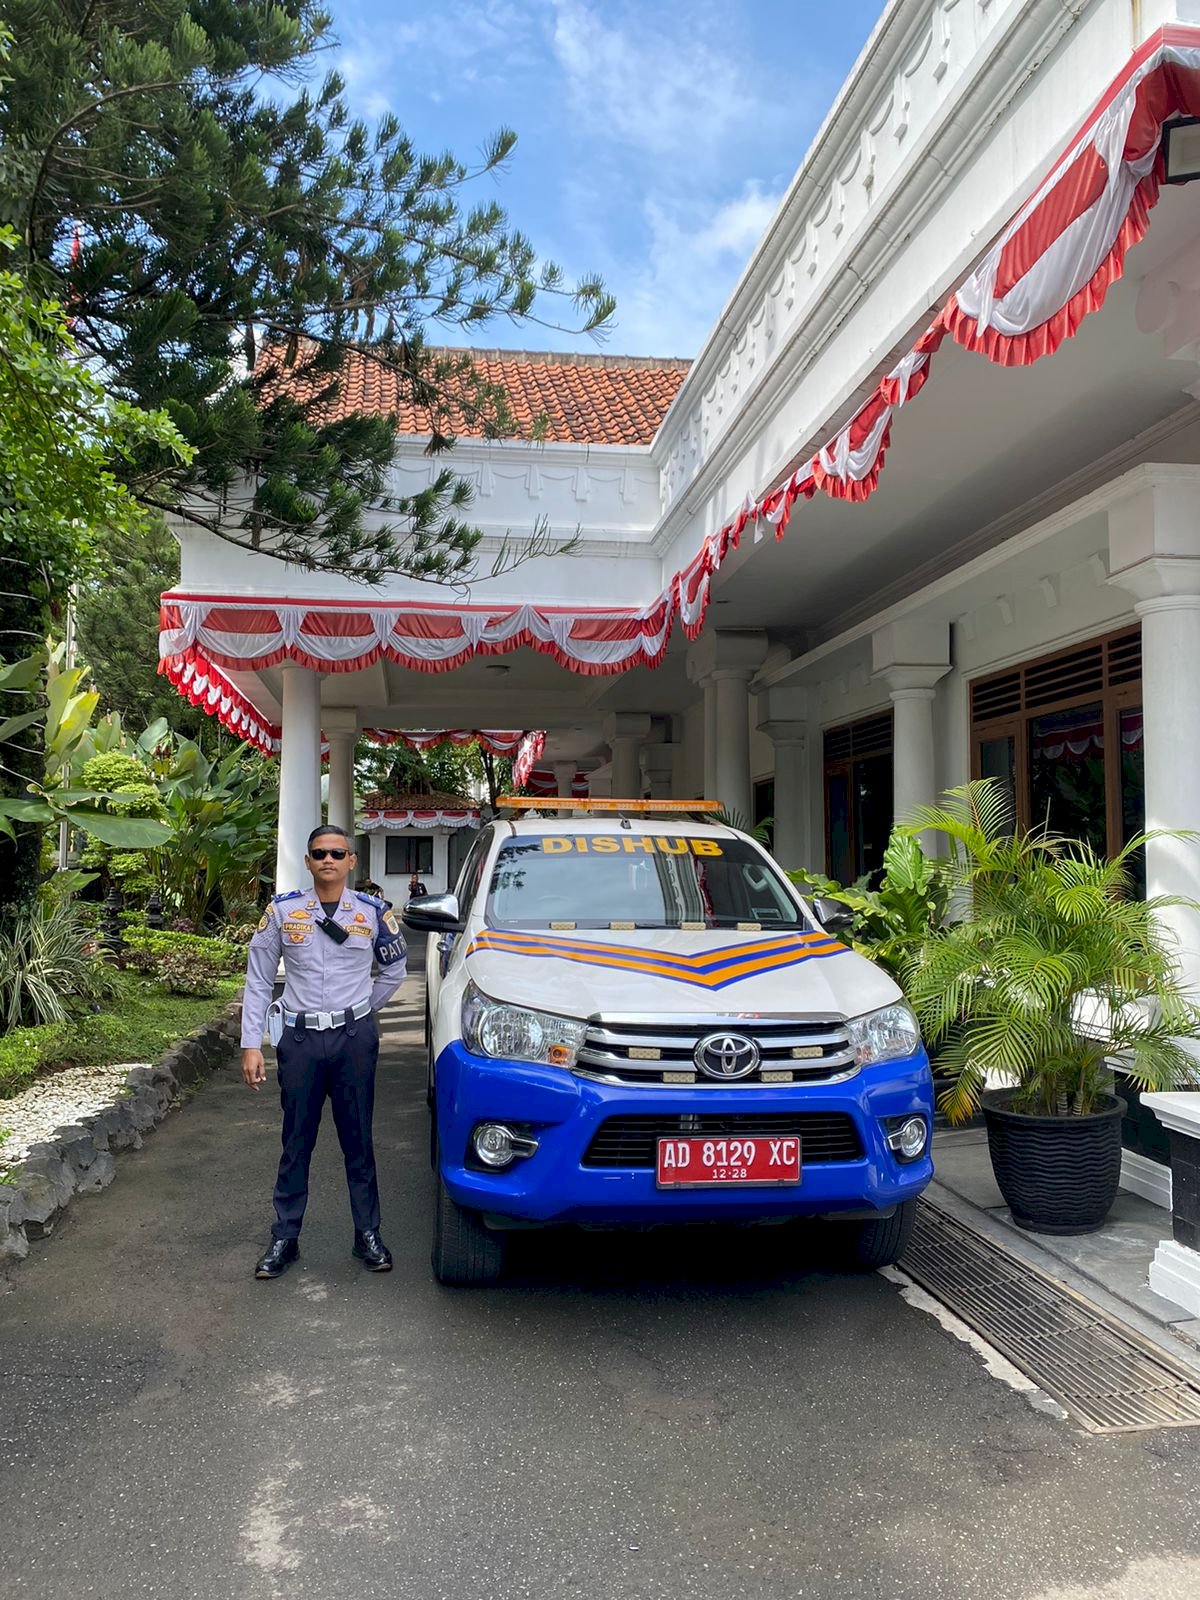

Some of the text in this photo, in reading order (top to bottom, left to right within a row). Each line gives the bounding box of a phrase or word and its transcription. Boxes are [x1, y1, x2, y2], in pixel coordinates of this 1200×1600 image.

[541, 836, 723, 856] DISHUB
[664, 1141, 795, 1168] AD 8129 XC
